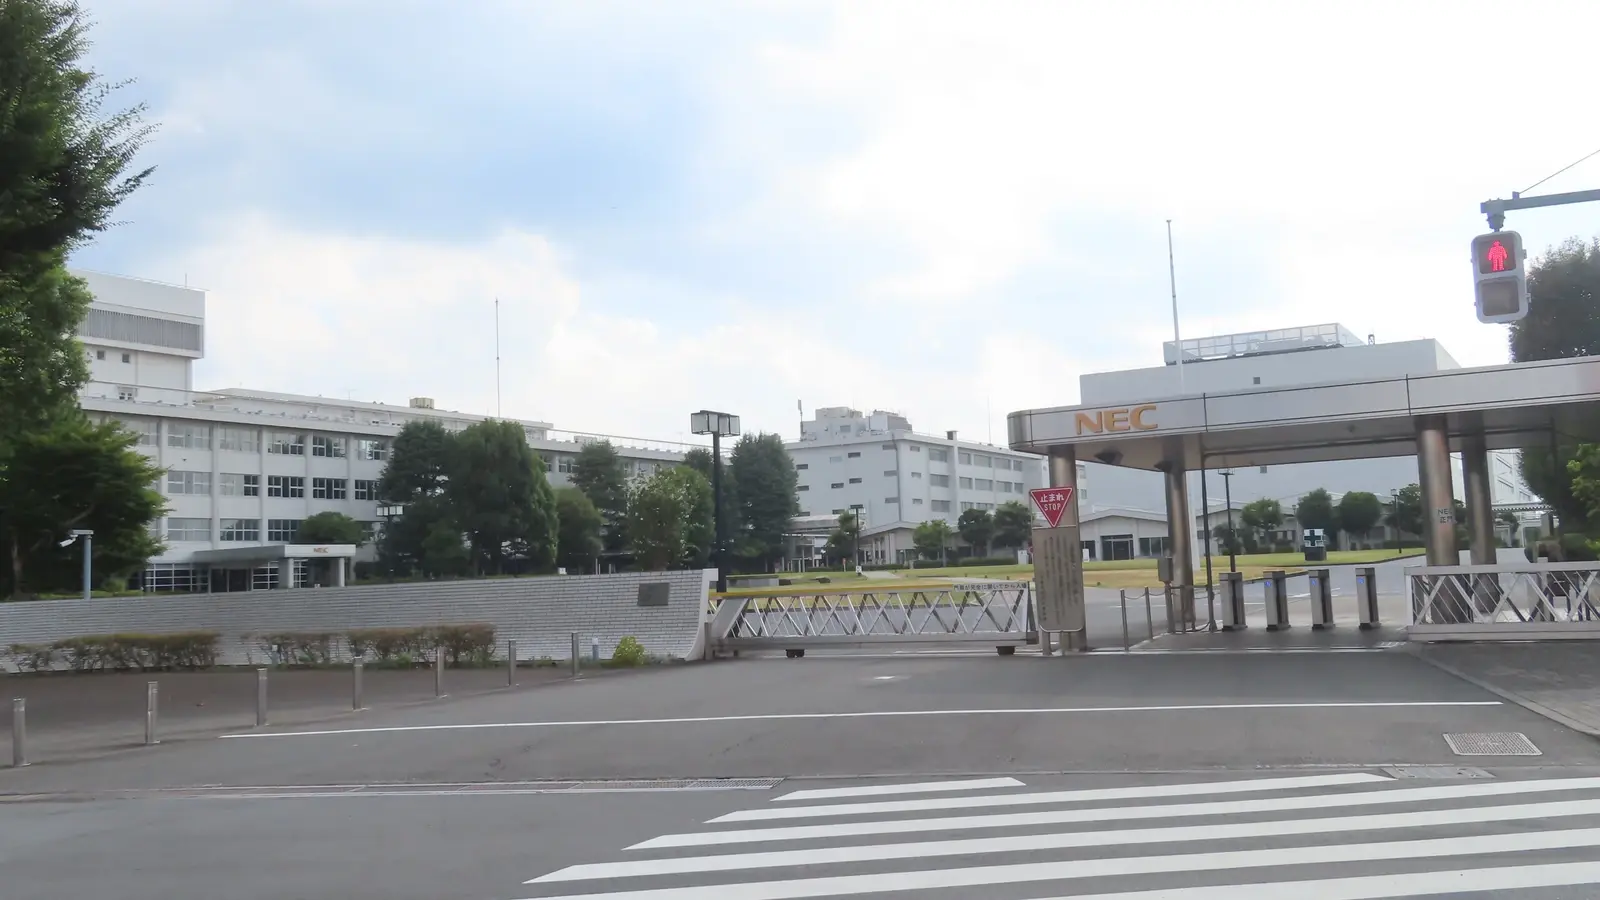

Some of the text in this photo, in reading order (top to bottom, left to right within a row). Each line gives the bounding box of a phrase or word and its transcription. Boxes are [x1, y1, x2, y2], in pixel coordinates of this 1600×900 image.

[1074, 404, 1158, 435] NEC
[1040, 493, 1064, 503] 止まれ
[1044, 503, 1061, 511] STOP
